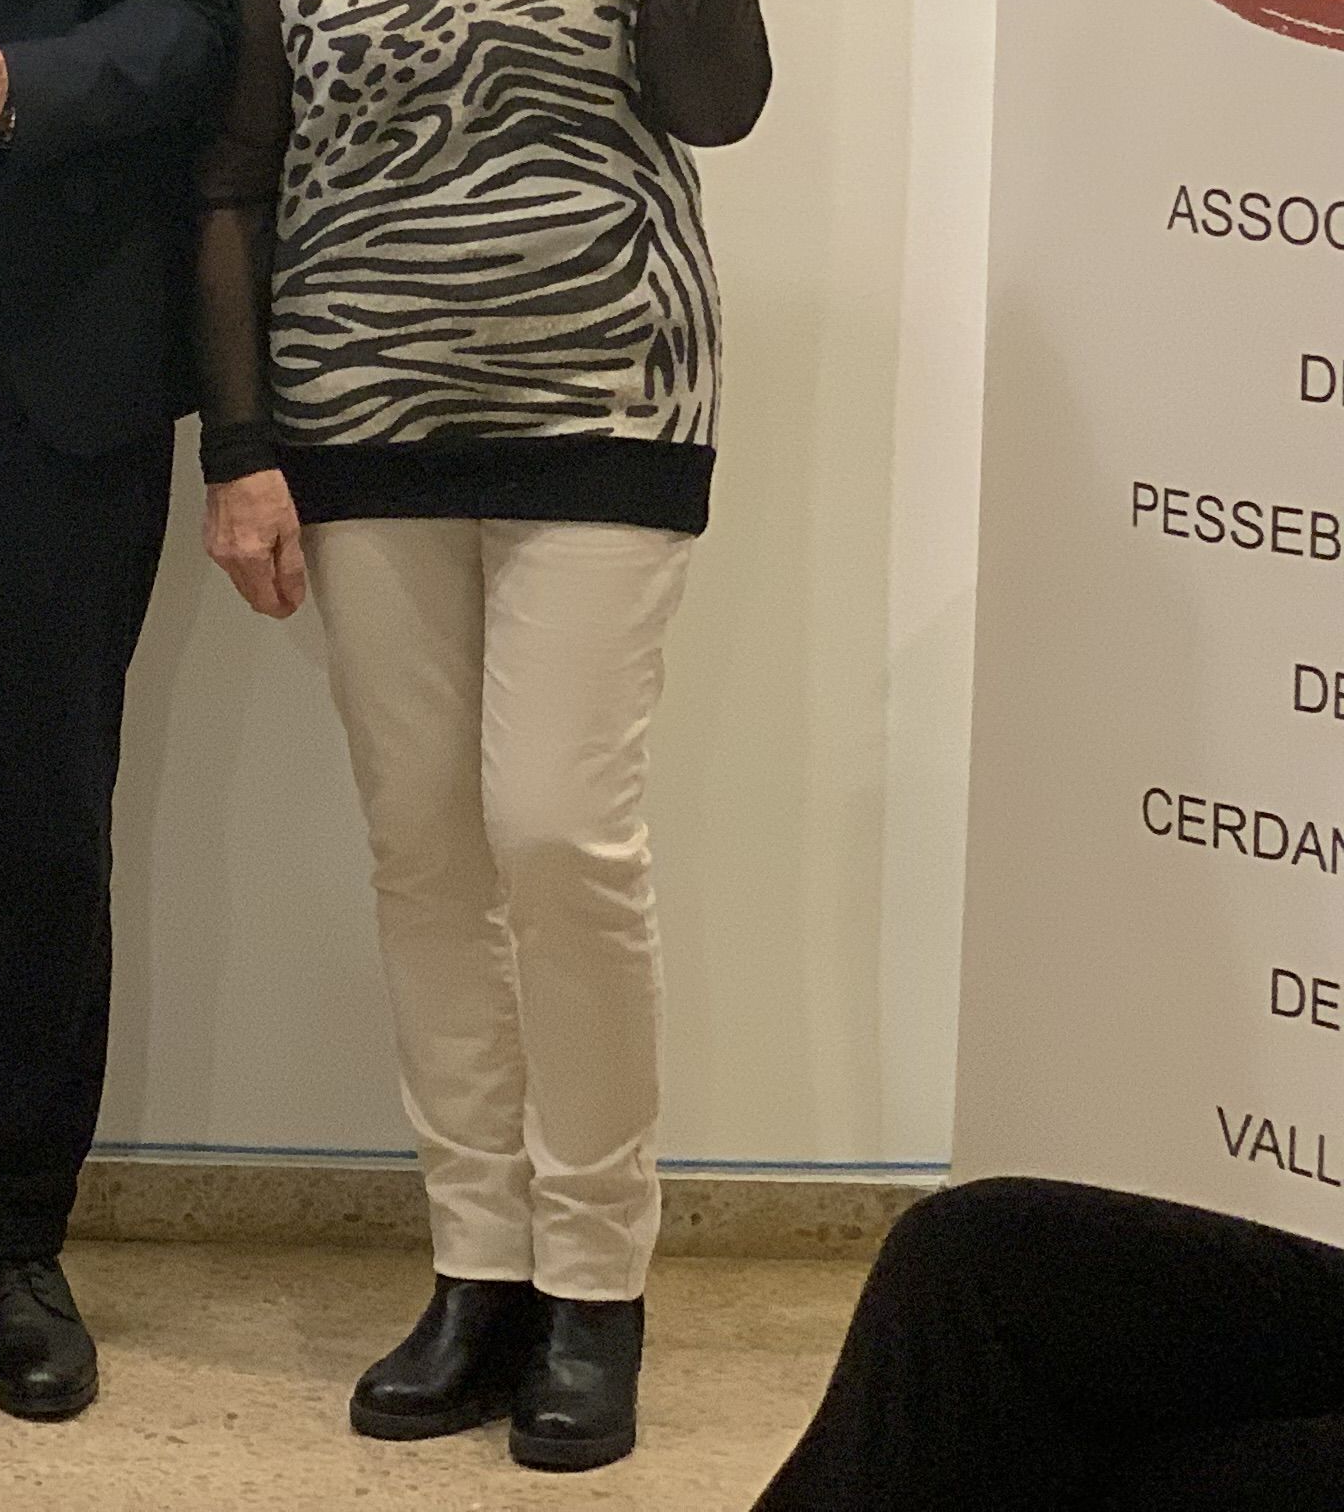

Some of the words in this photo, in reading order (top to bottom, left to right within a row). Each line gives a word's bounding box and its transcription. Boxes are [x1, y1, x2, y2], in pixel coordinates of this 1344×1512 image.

[1301, 353, 1344, 407] D
[1132, 481, 1342, 561] PESSEB
[1271, 967, 1341, 1031] DE
[1216, 1105, 1342, 1187] VALL
